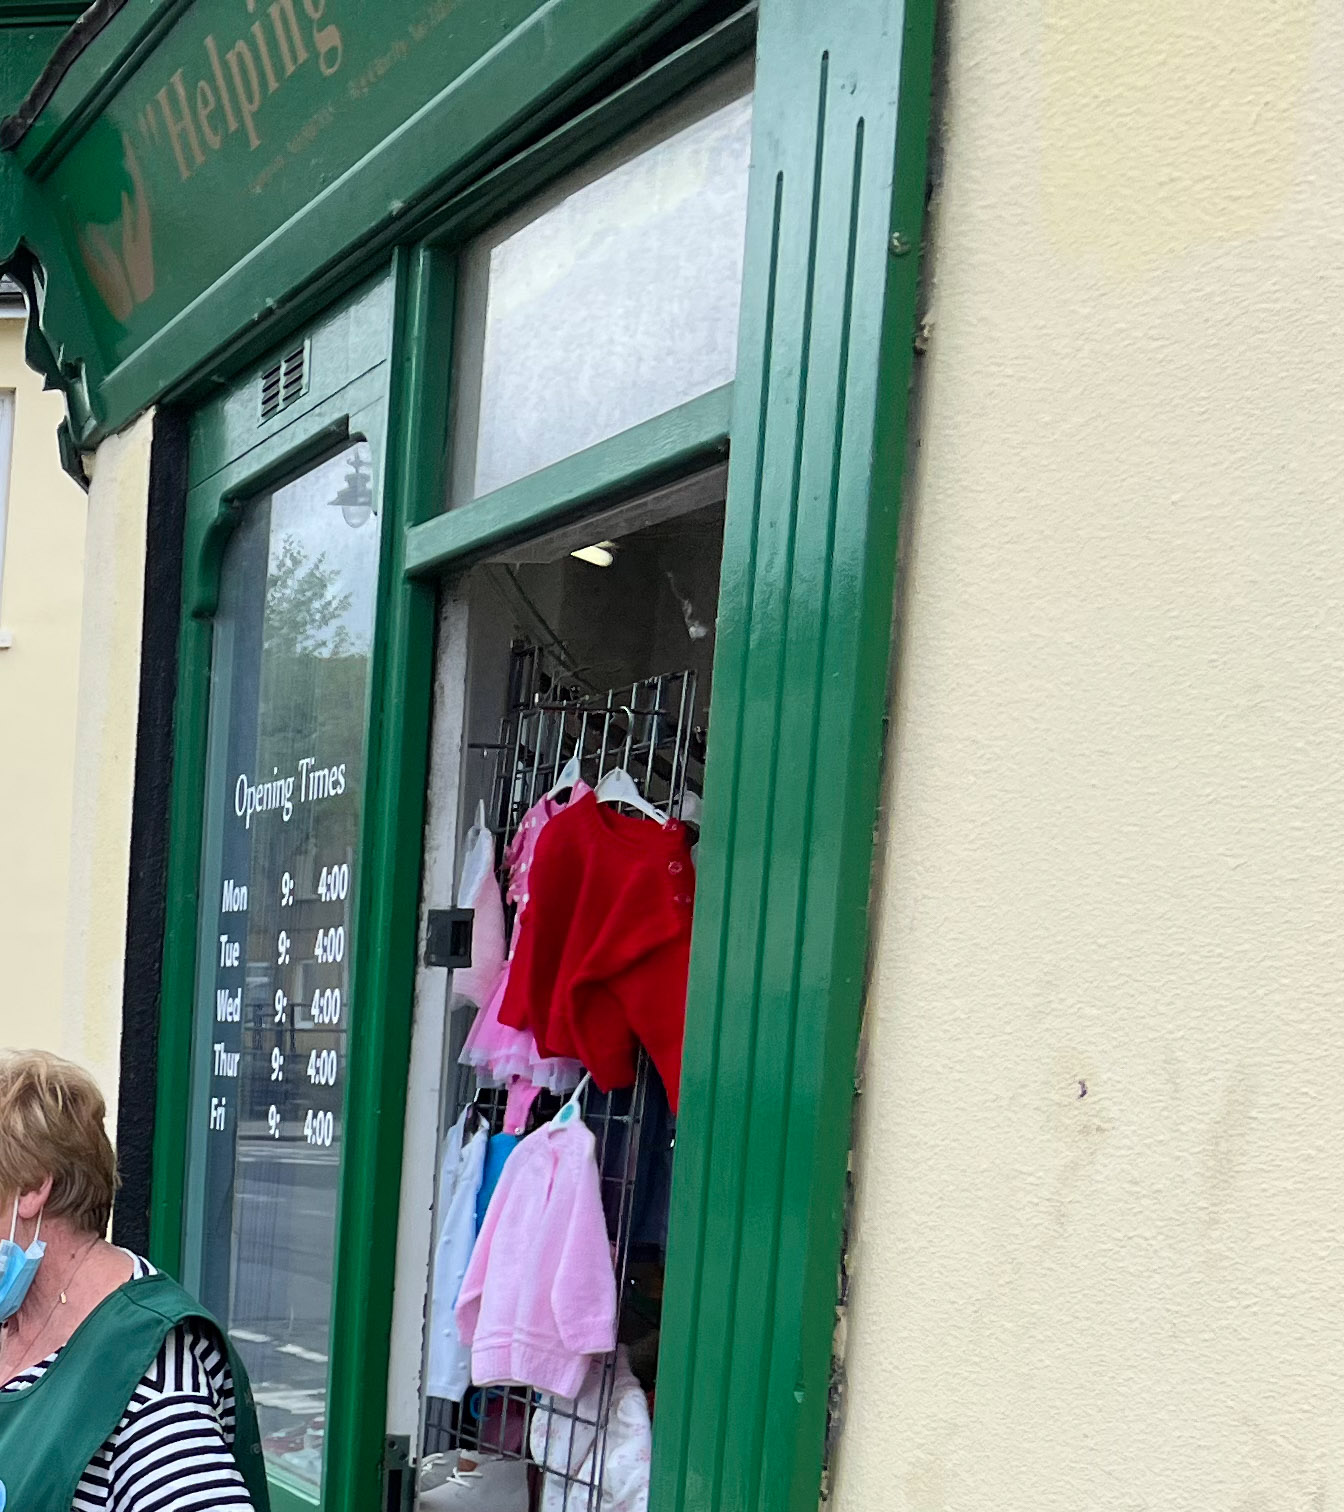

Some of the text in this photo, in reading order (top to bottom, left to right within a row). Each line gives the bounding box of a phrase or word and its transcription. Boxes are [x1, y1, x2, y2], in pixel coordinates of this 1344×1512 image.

[235, 757, 346, 830] Opening Times
[221, 879, 248, 913] Mon
[317, 863, 349, 902] 4:00
[219, 934, 240, 967] Tue
[314, 926, 345, 964] 4:00
[216, 987, 242, 1022] Wed
[311, 988, 341, 1024] 4:00
[214, 1042, 240, 1077] Thur
[306, 1049, 337, 1086] 4:00
[209, 1097, 226, 1131] Fri
[303, 1109, 334, 1147] 4:00
